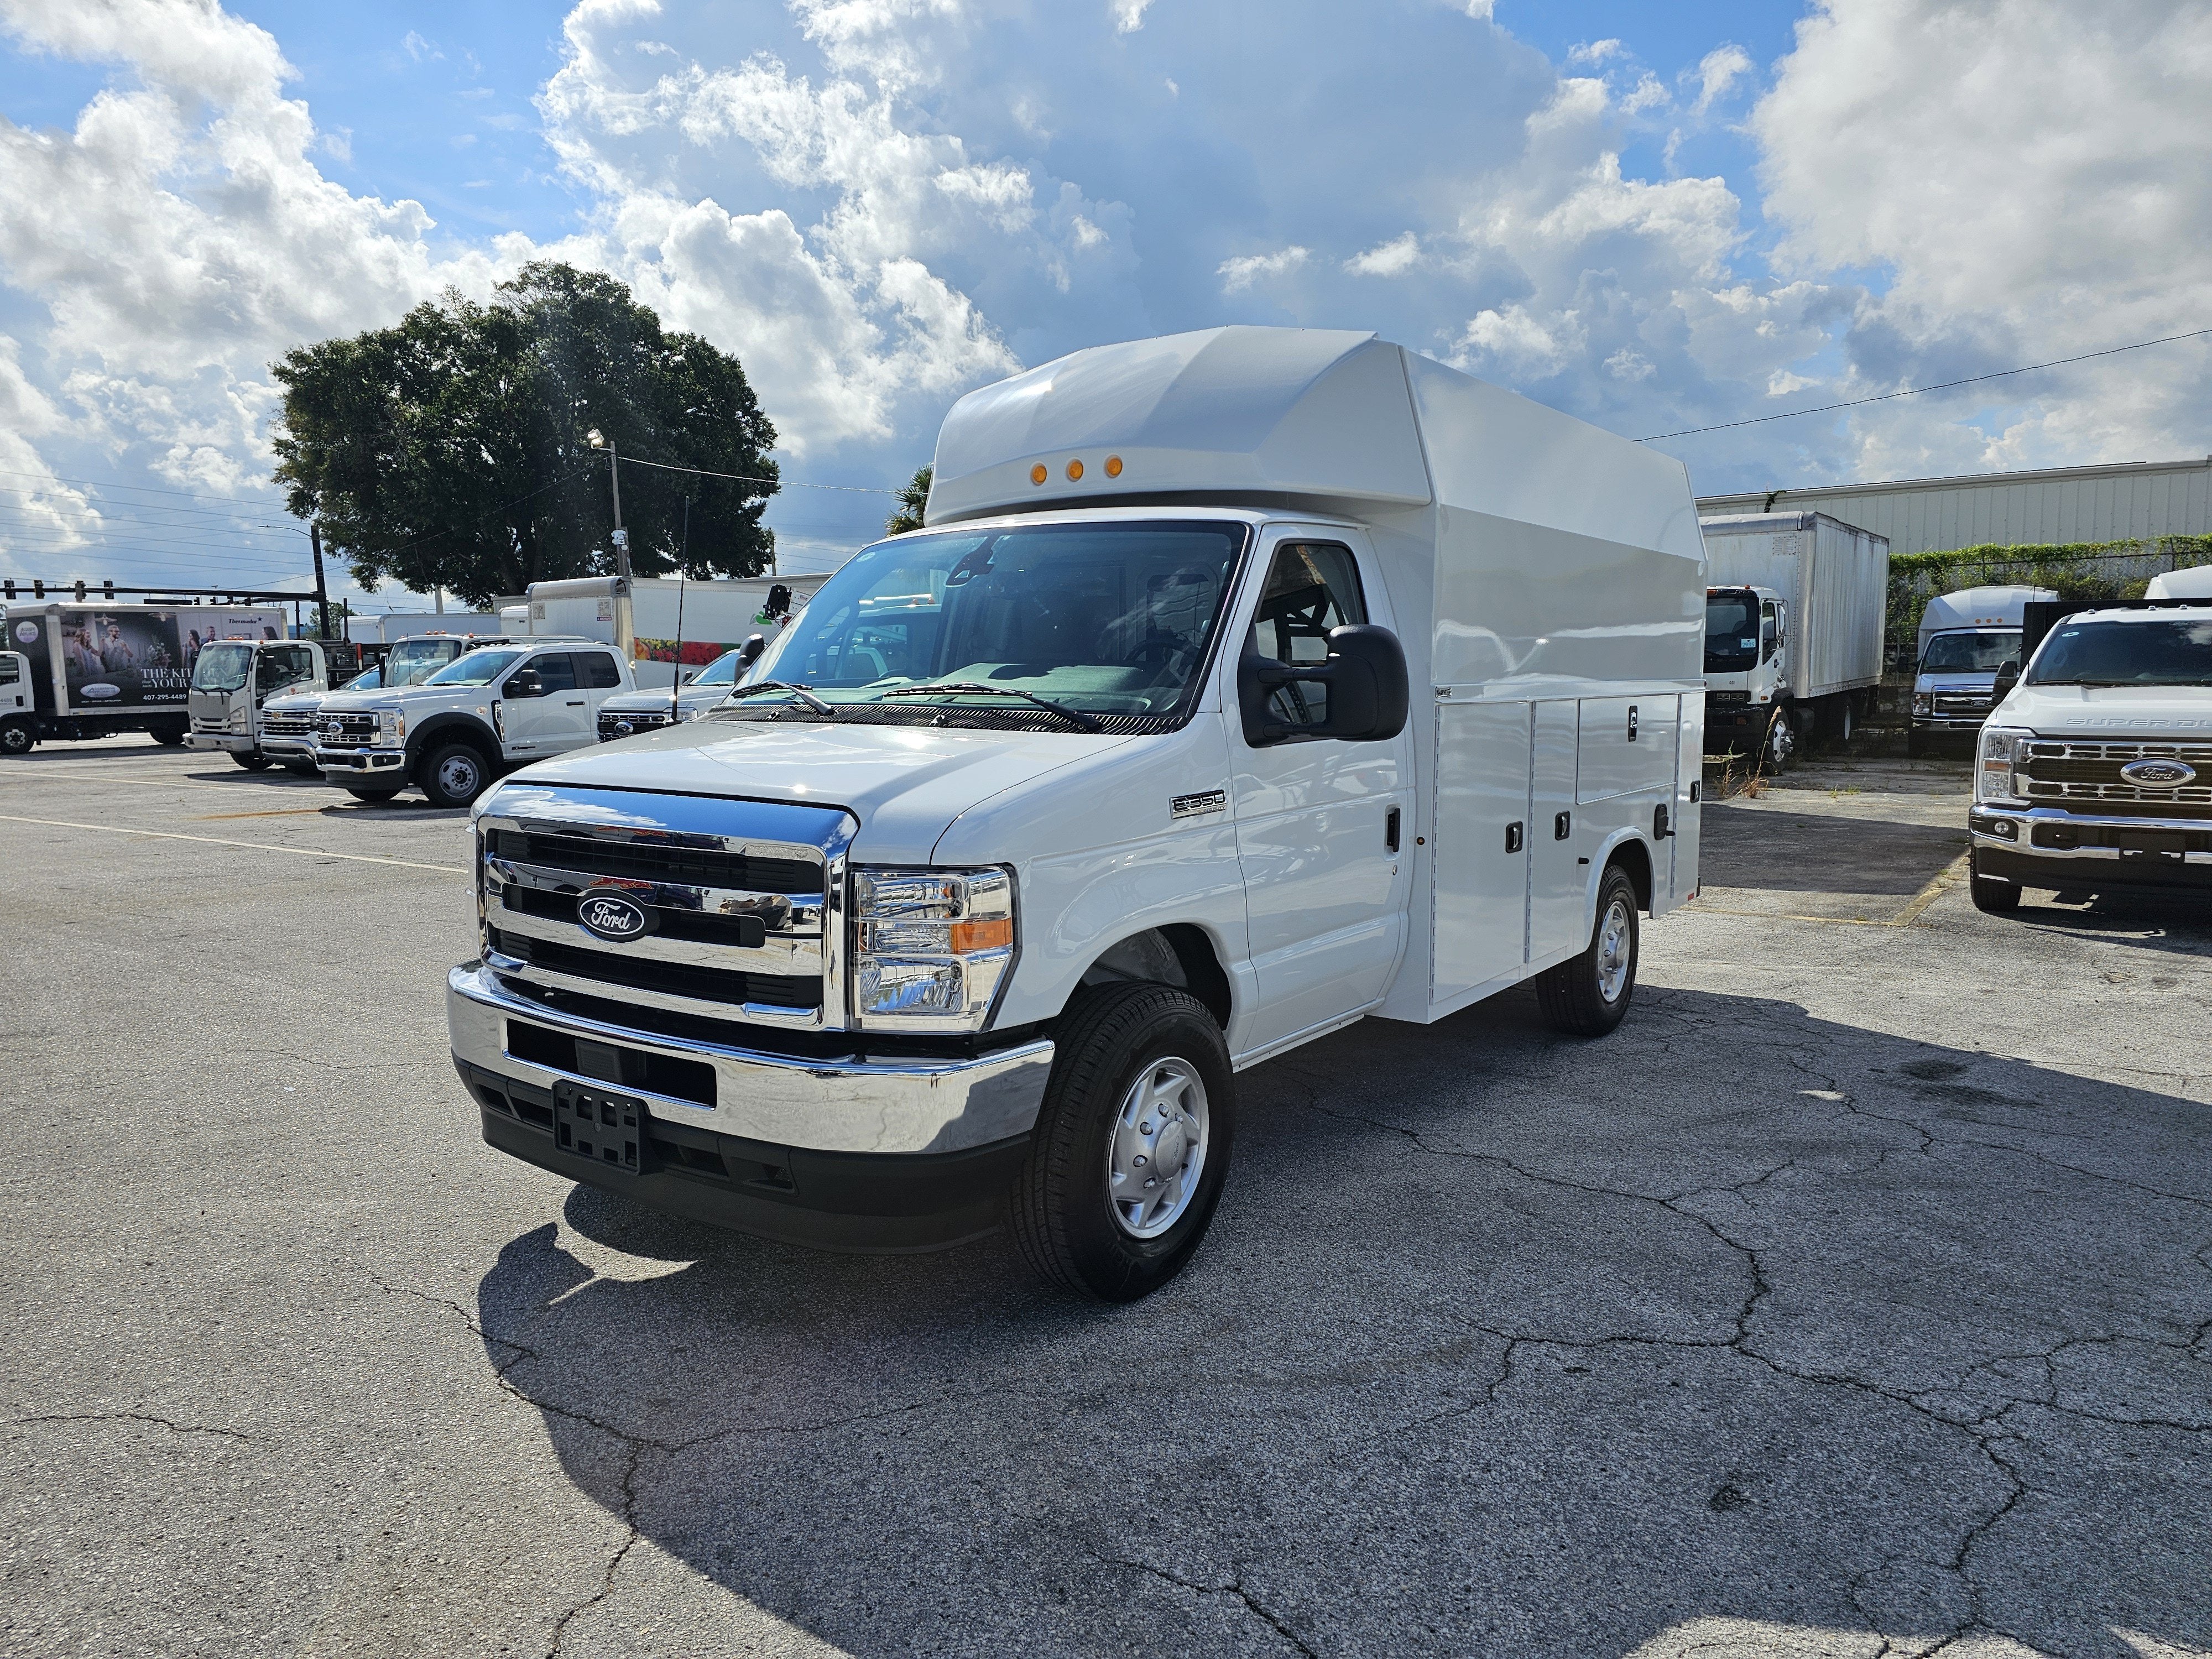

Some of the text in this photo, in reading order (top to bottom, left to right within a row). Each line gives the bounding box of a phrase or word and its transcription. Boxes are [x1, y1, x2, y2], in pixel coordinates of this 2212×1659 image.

[140, 668, 168, 679] THE
[152, 678, 187, 688] YOUR
[2066, 718, 2171, 727] SUPER
[2140, 766, 2175, 780] Ford
[591, 901, 631, 930] Ford
